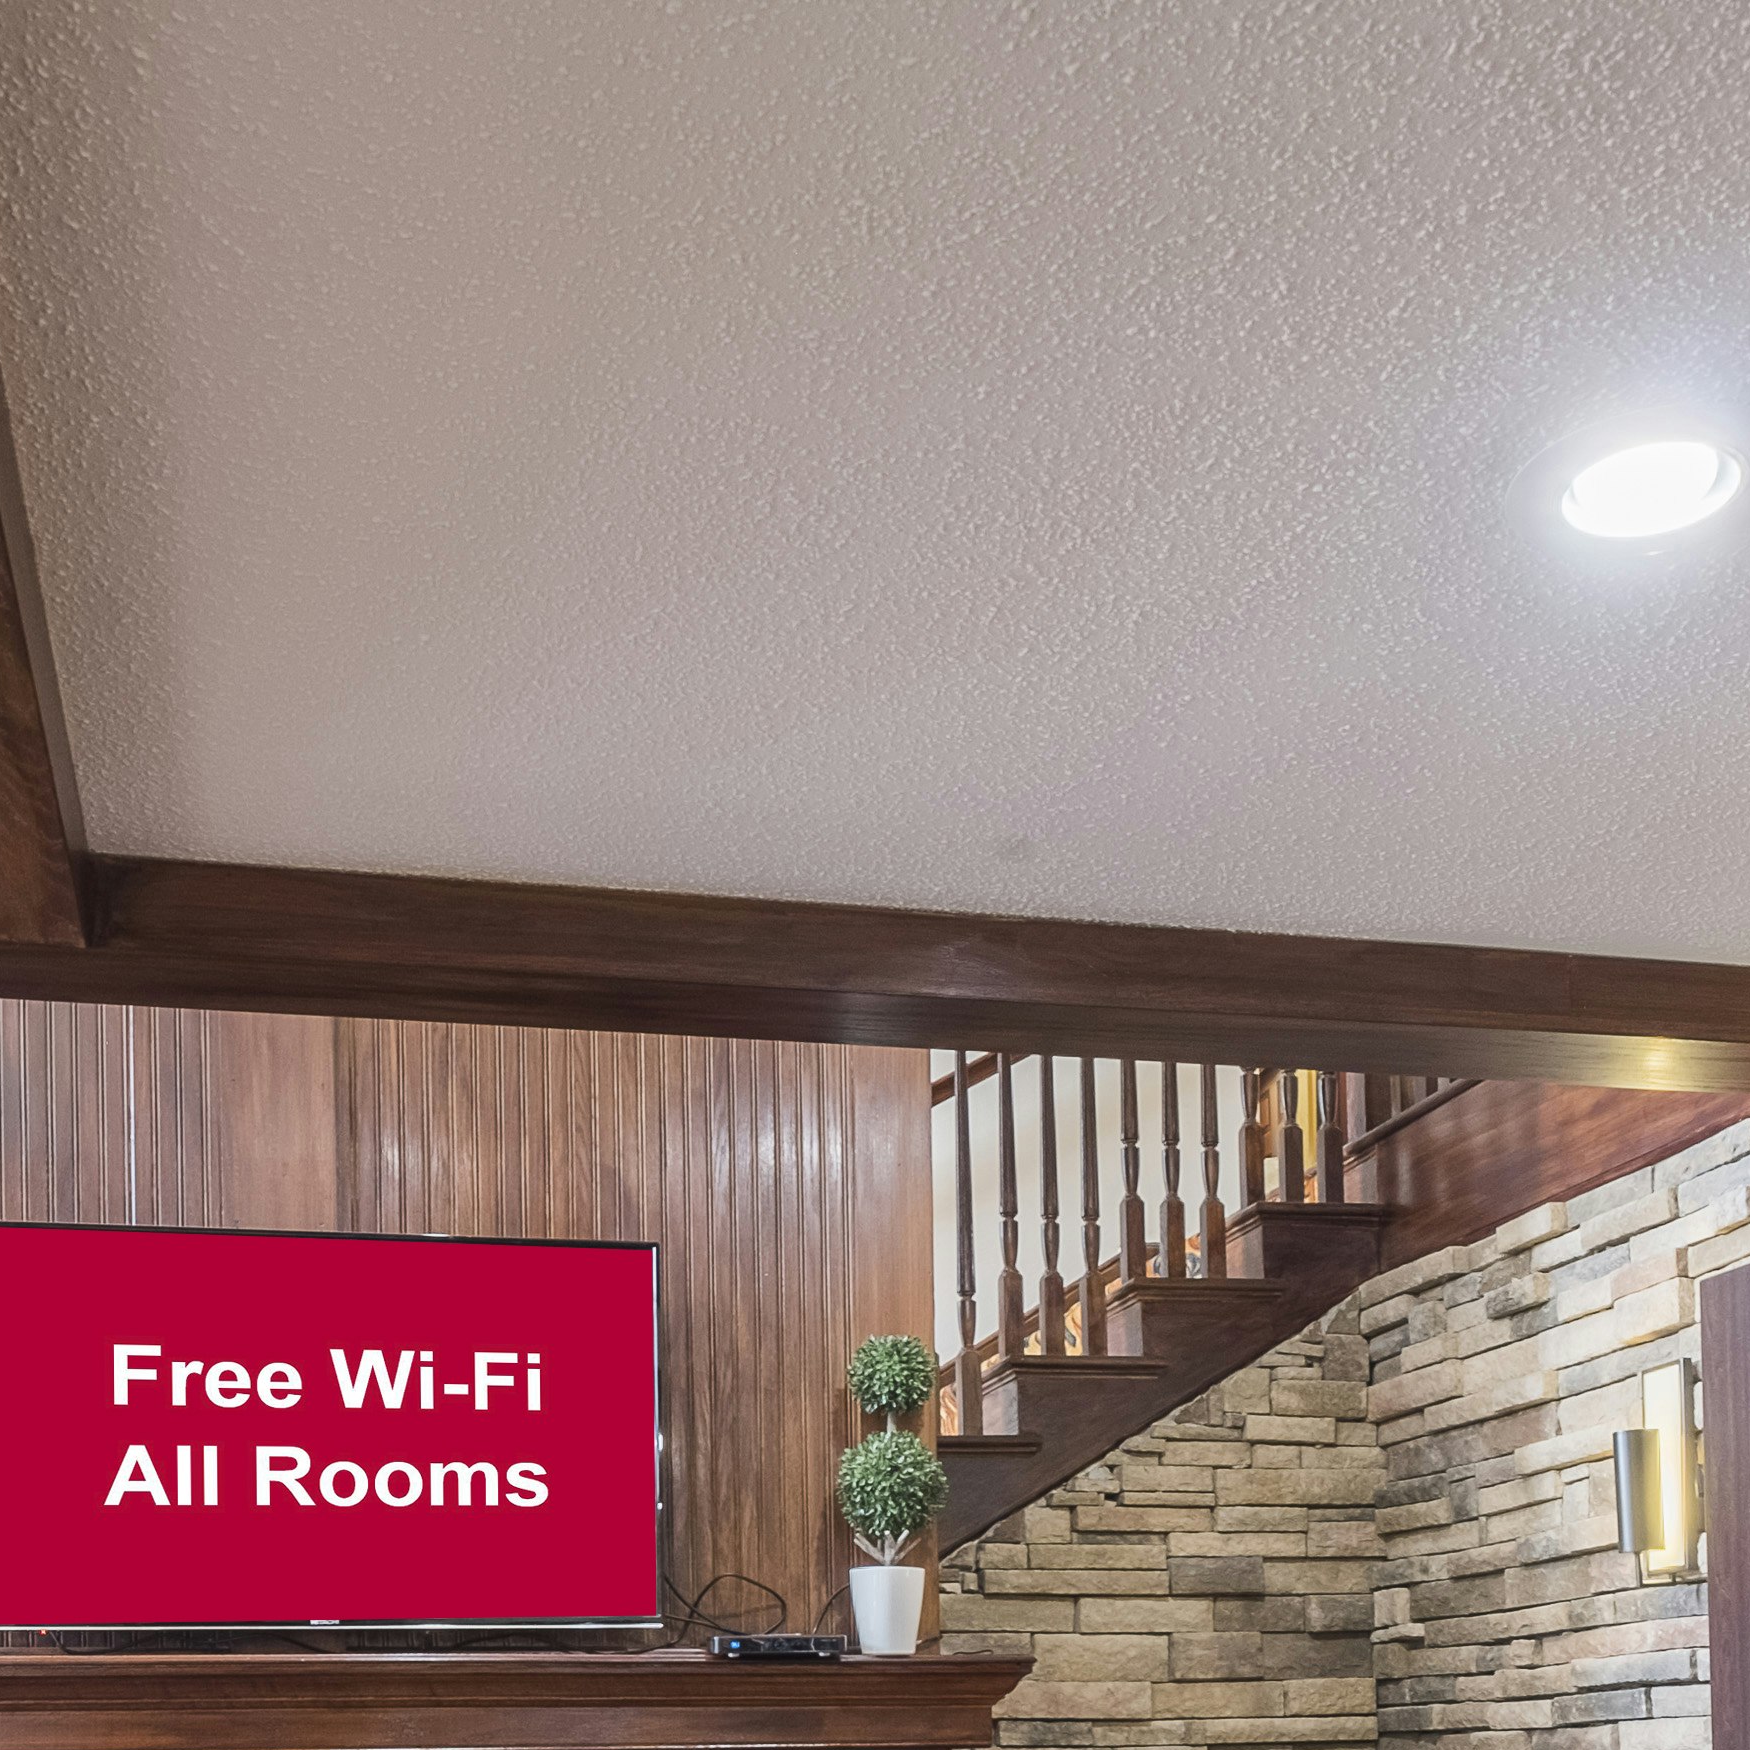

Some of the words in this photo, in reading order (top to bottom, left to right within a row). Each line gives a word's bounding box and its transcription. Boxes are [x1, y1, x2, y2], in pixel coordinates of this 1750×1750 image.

[112, 1343, 304, 1409] Free
[329, 1348, 542, 1411] Wi-Fi
[103, 1443, 218, 1506] All
[254, 1445, 550, 1508] Rooms
